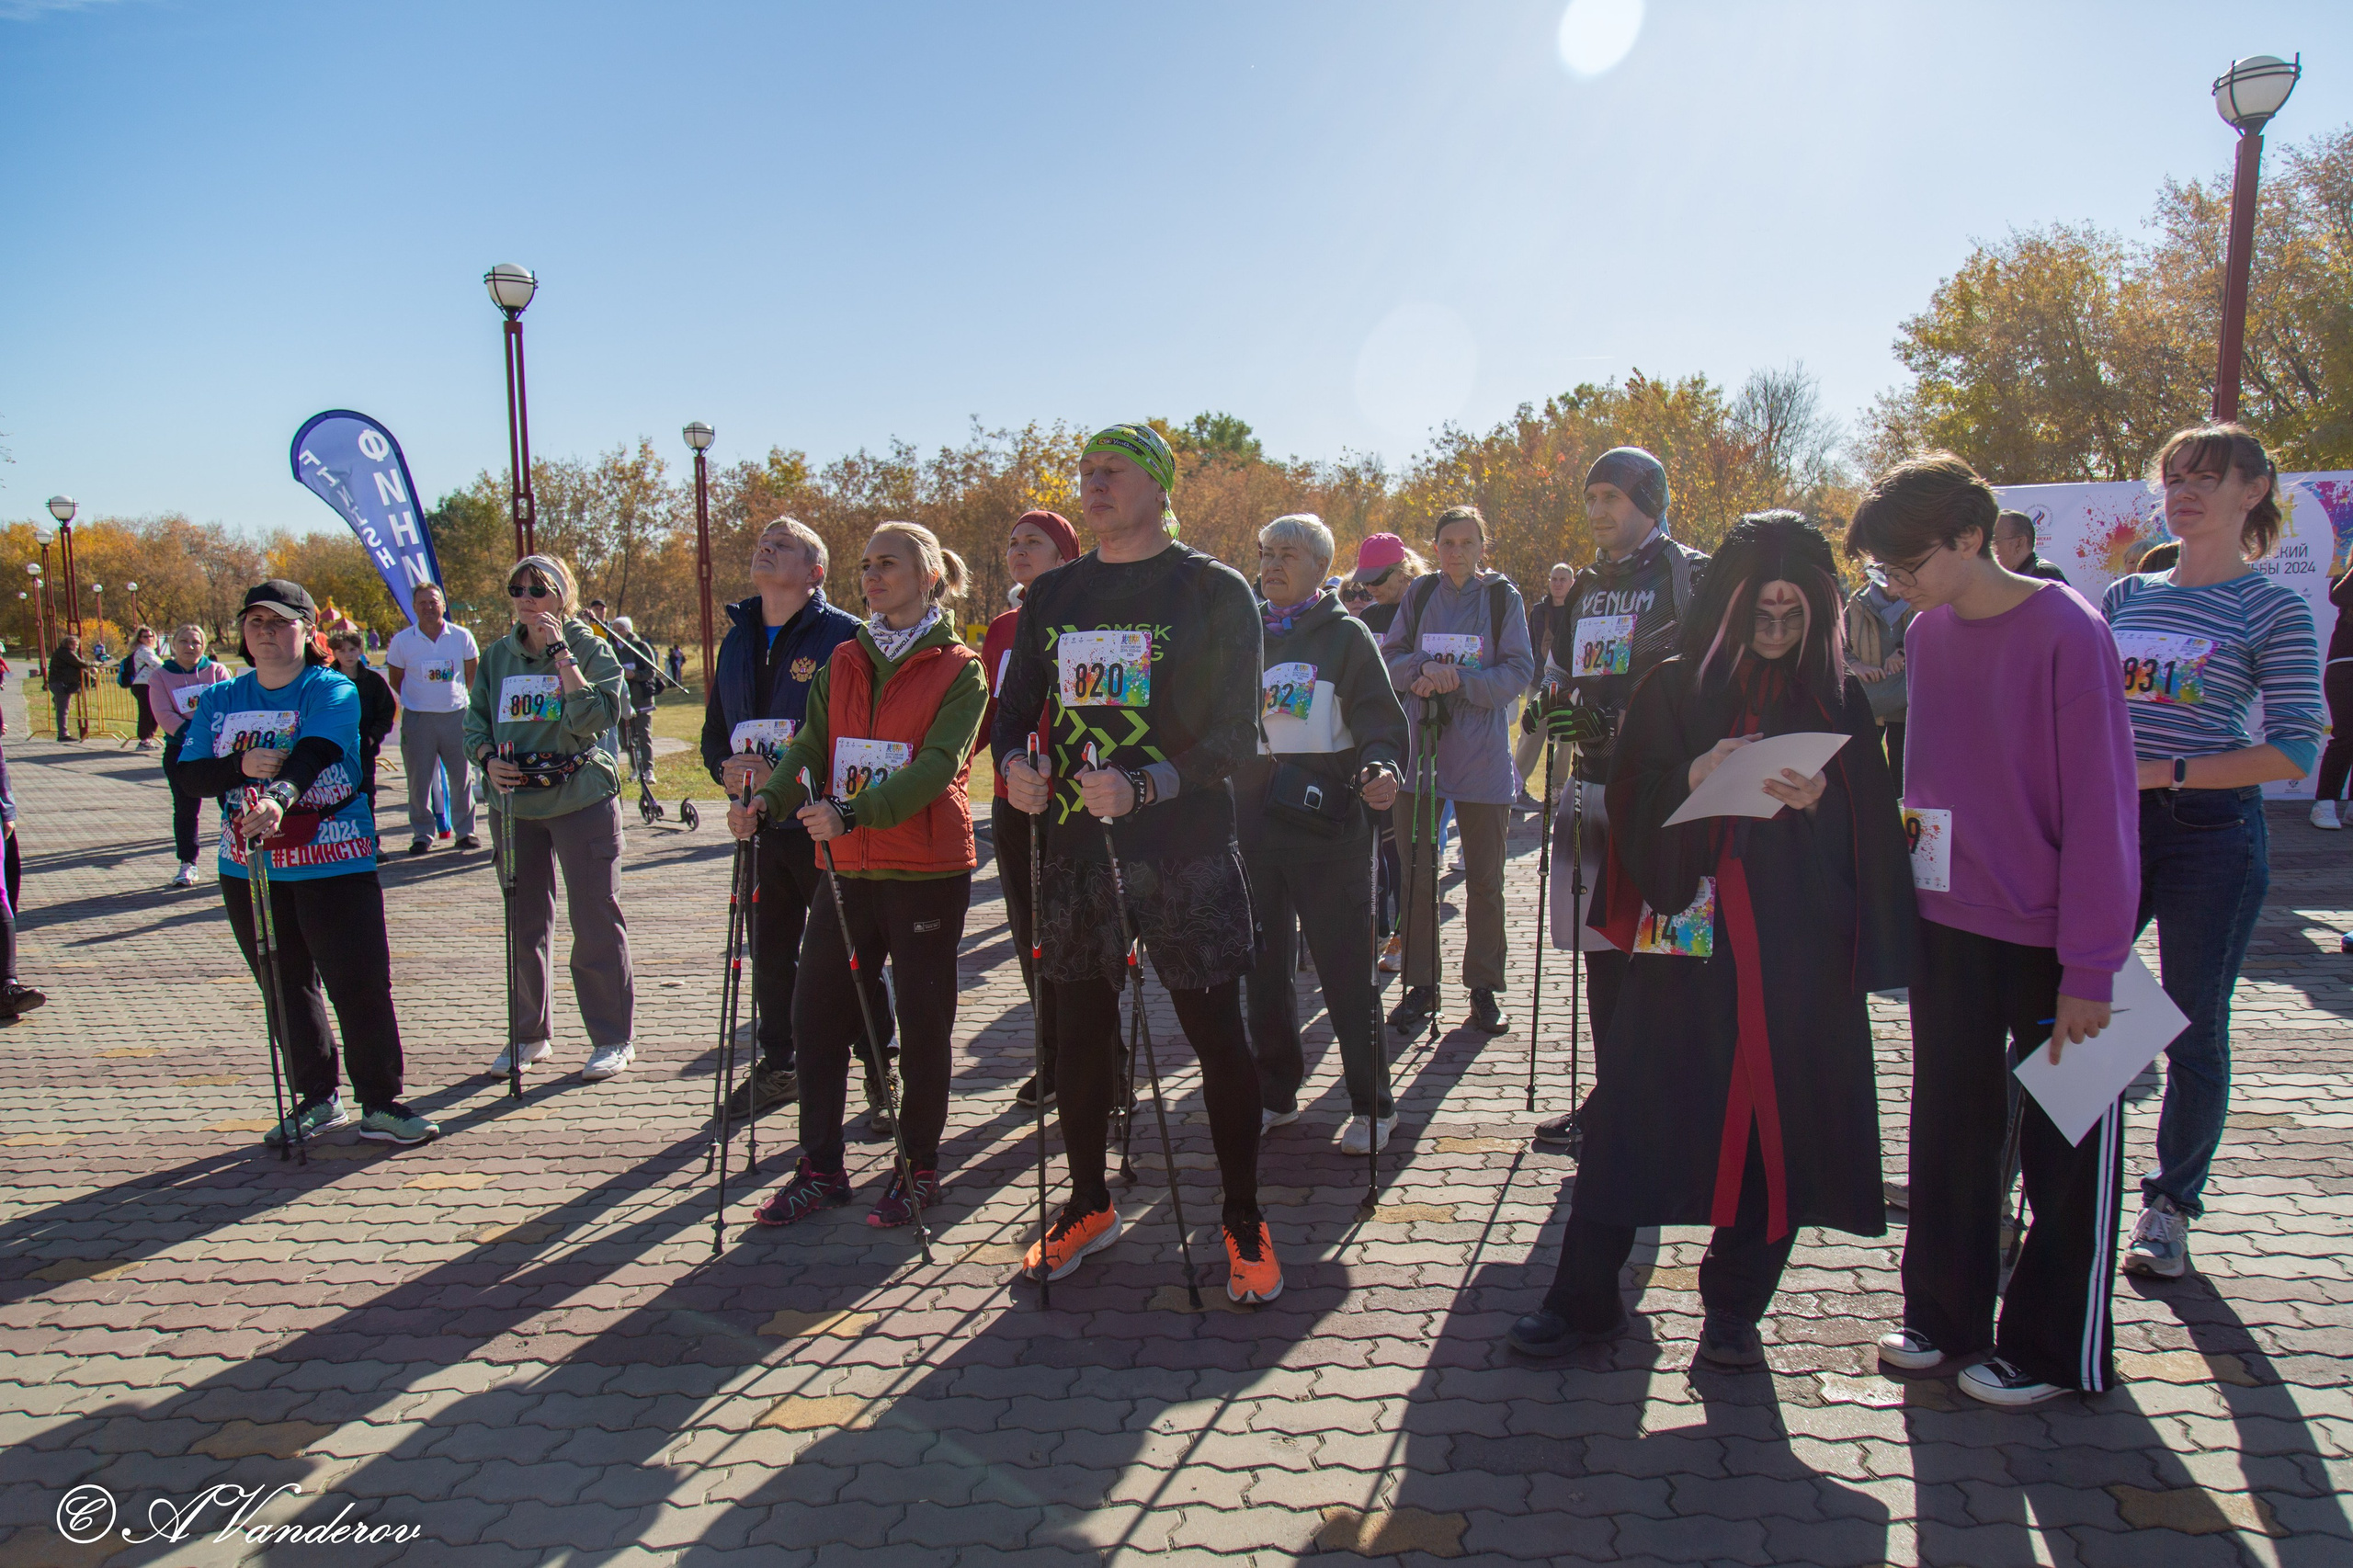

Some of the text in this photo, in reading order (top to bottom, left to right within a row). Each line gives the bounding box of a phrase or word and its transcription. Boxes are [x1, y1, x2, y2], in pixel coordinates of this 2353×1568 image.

[2284, 561, 2316, 574] 2024
[1582, 589, 1654, 616] VENUM
[888, 637, 910, 661] TORERO
[1583, 640, 1617, 669] 825
[428, 669, 448, 681] 386
[1074, 663, 1124, 698] 820
[2124, 657, 2176, 695] 831
[510, 694, 545, 716] 809
[233, 730, 276, 755] 808
[1574, 780, 1583, 812] LEKI
[318, 819, 360, 844] 2024
[1112, 858, 1125, 894] LEKI
